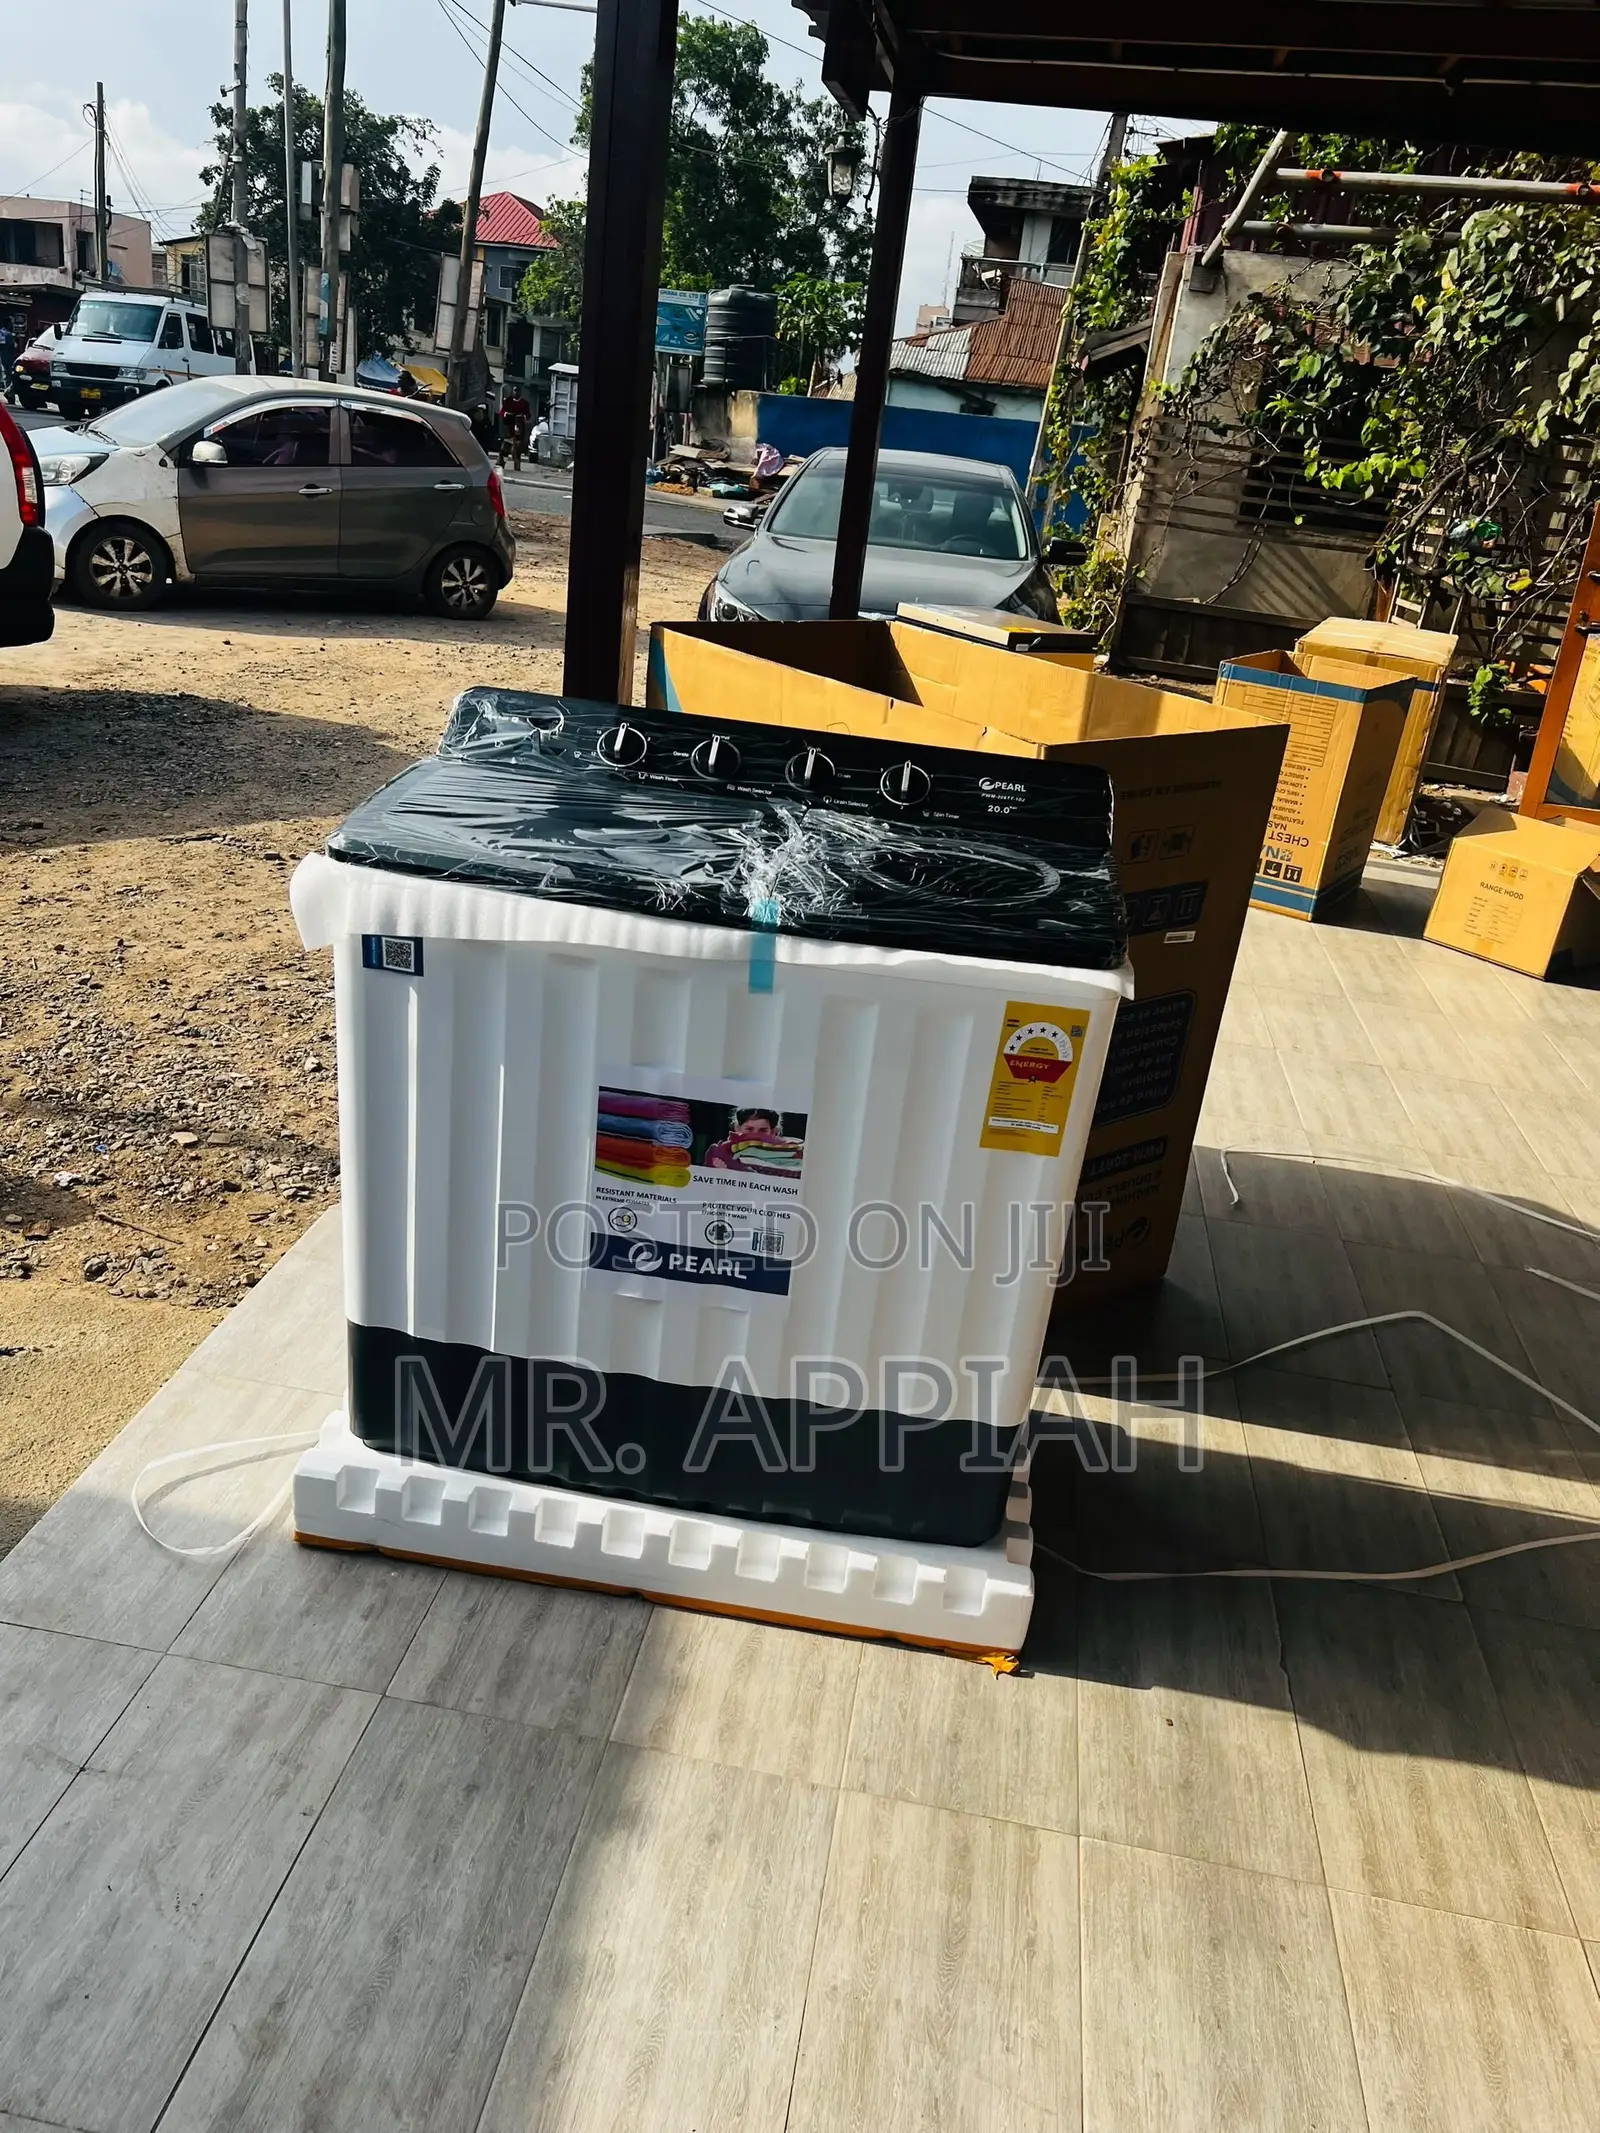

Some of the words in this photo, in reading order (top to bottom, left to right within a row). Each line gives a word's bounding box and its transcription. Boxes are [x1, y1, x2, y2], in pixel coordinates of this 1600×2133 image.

[995, 781, 1026, 792] PEARL
[1268, 831, 1310, 848] CHEST
[1480, 882, 1503, 894] RANGE
[1504, 889, 1524, 900] HOOD
[1010, 1060, 1050, 1070] ENERGY
[693, 1175, 714, 1184] SAVE
[716, 1178, 736, 1187] TIME
[750, 1182, 770, 1192] EACH
[772, 1186, 798, 1196] WASH
[596, 1186, 635, 1198] RESISTANT
[637, 1191, 677, 1204] MATERIALS
[702, 1202, 735, 1210] PROTECT
[736, 1206, 758, 1215] YOUR
[758, 1210, 791, 1220] CLOTHES
[669, 1253, 747, 1280] PEARL
